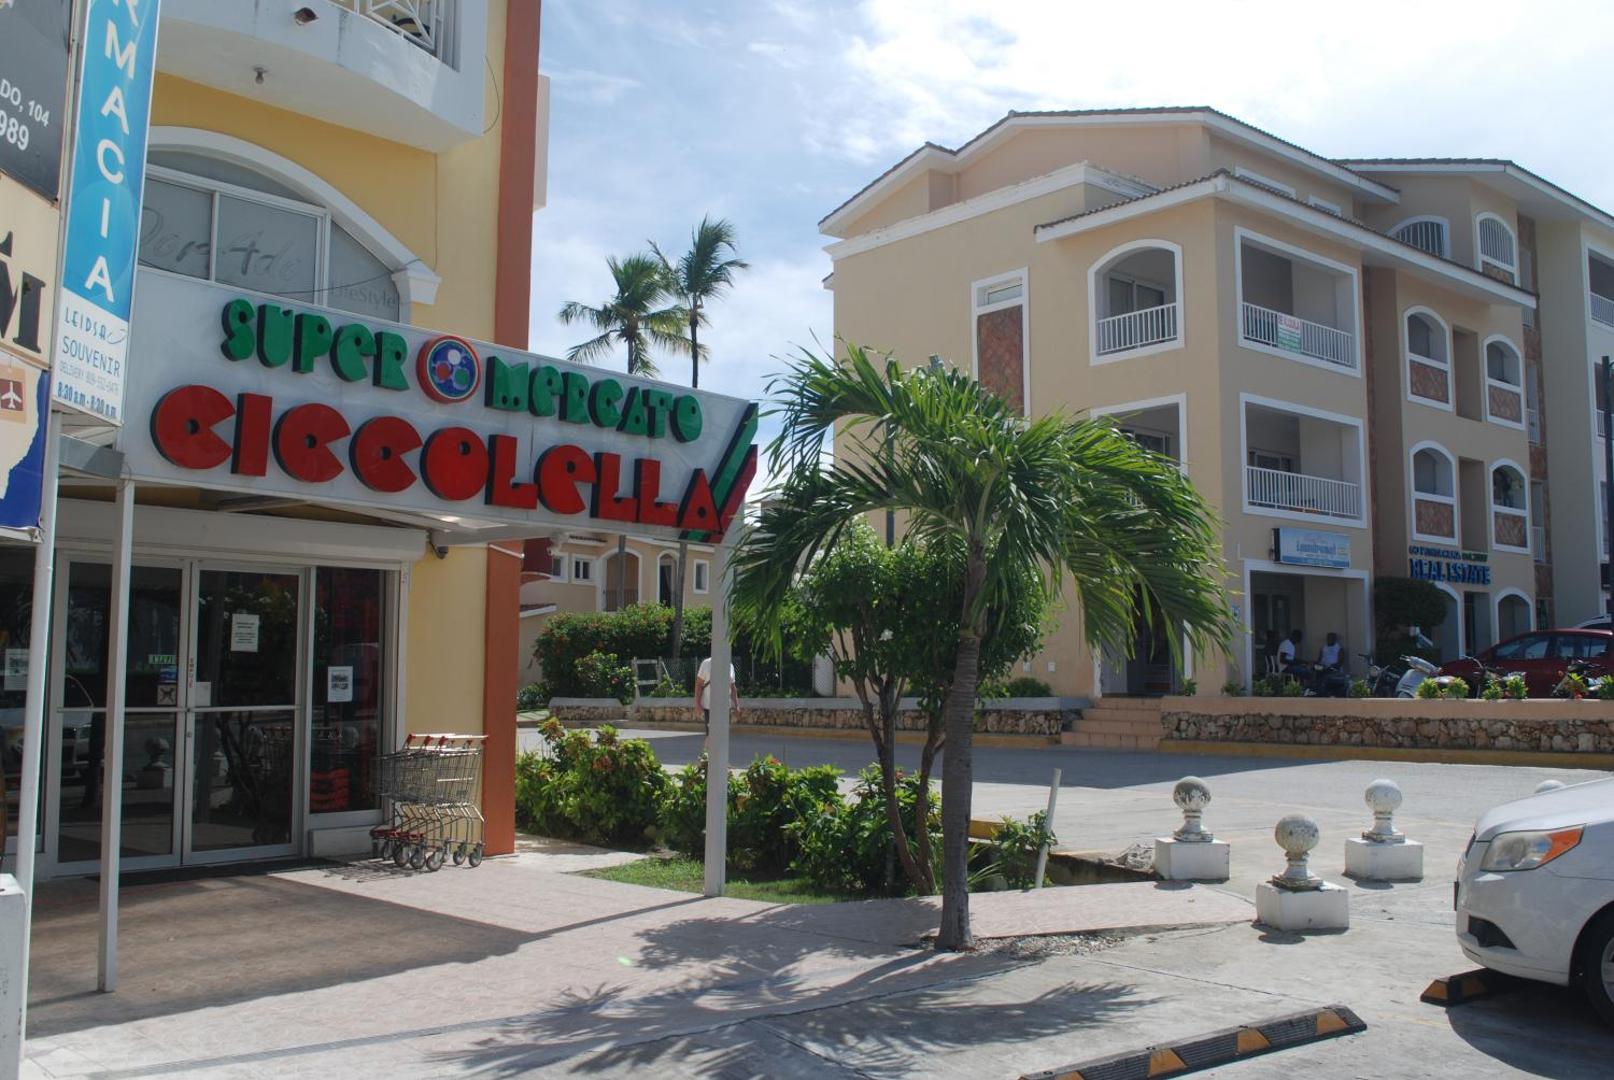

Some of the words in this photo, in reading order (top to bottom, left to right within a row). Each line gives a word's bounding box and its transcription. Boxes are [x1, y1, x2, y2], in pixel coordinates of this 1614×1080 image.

[28, 100, 50, 128] 104
[62, 335, 121, 378] SOUVENIR
[221, 299, 411, 391] SUPER
[484, 355, 703, 444] MERCATO
[150, 384, 723, 535] CICCOLELLA
[1409, 558, 1445, 582] REAL
[1446, 560, 1491, 585] ESTATE
